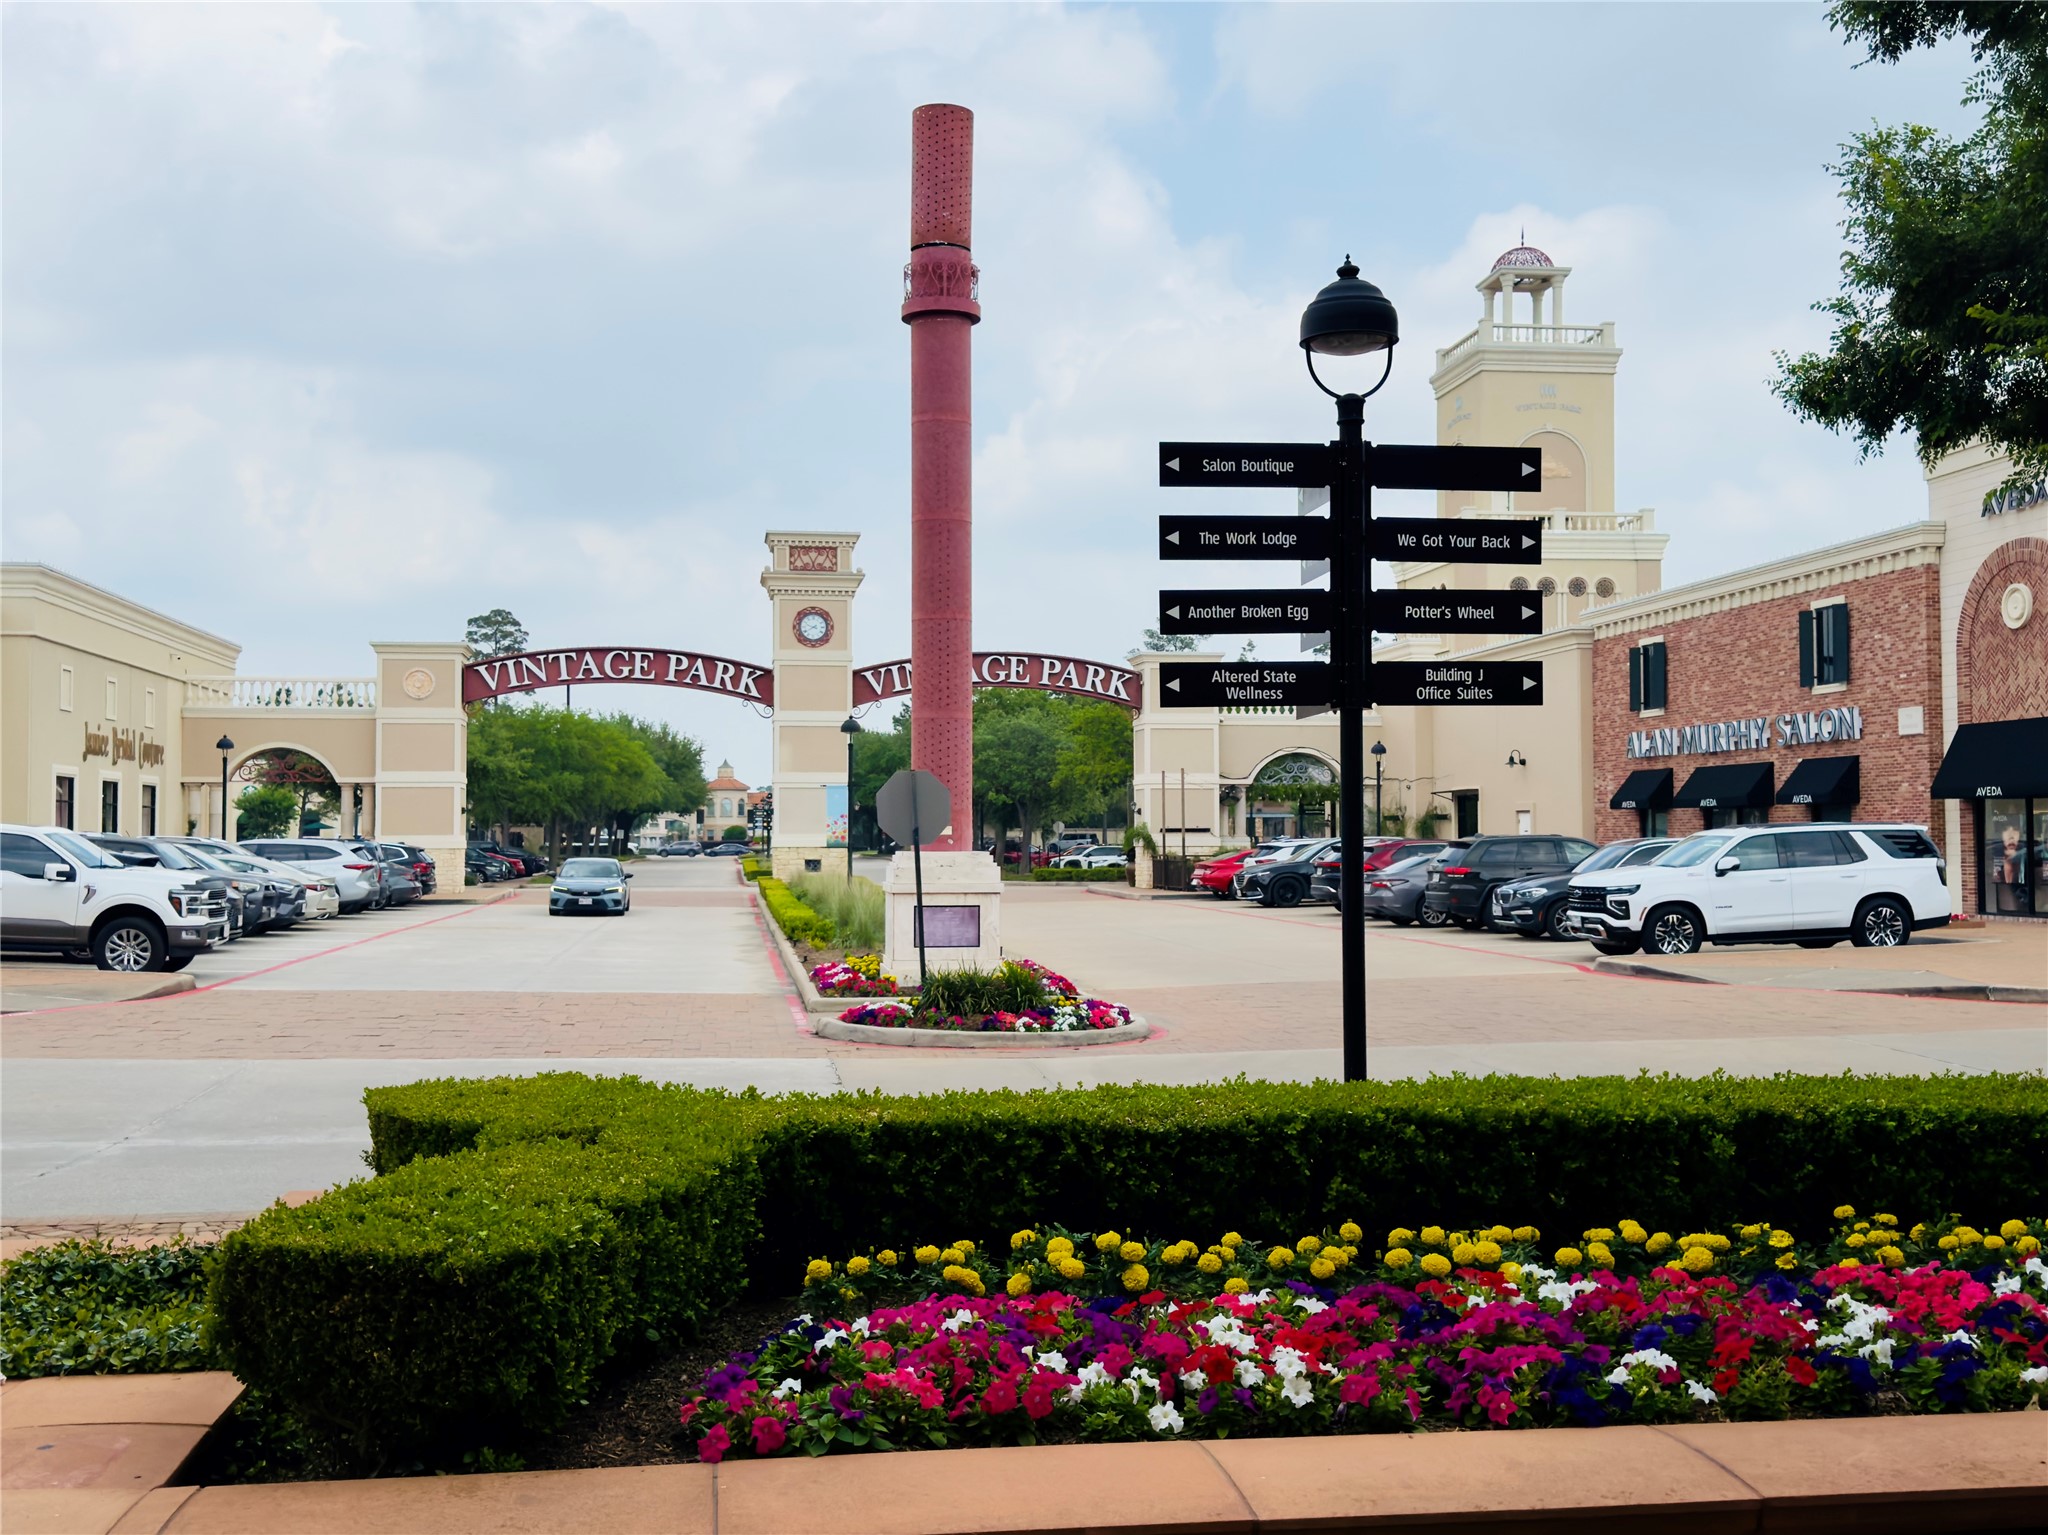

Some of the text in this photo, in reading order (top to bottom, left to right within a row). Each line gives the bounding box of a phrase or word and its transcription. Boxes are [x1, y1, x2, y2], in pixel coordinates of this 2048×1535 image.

[1202, 459, 1295, 475] Salon Boutique
[1198, 532, 1297, 549] The Work Lodge
[1397, 534, 1511, 549] We Got Your Back
[1188, 605, 1309, 621] Another Broken Egg
[1405, 605, 1495, 620] Potter's Wheel
[474, 650, 765, 698] VINTAGE PARK
[861, 655, 1133, 701] VIGE PARK
[1211, 669, 1297, 683] Altered State
[1425, 668, 1484, 684] Building J
[1225, 685, 1283, 700] Wellness
[1416, 685, 1493, 700] Office Suites
[1627, 727, 1680, 758] ALAN
[1681, 717, 1770, 754] MURPHY
[1775, 706, 1863, 746] SALON
[1792, 794, 1813, 804] AVEDA
[1975, 786, 2003, 797] AVEDA
[1621, 800, 1637, 809] AVEDA
[1700, 798, 1718, 807] AVEDA
